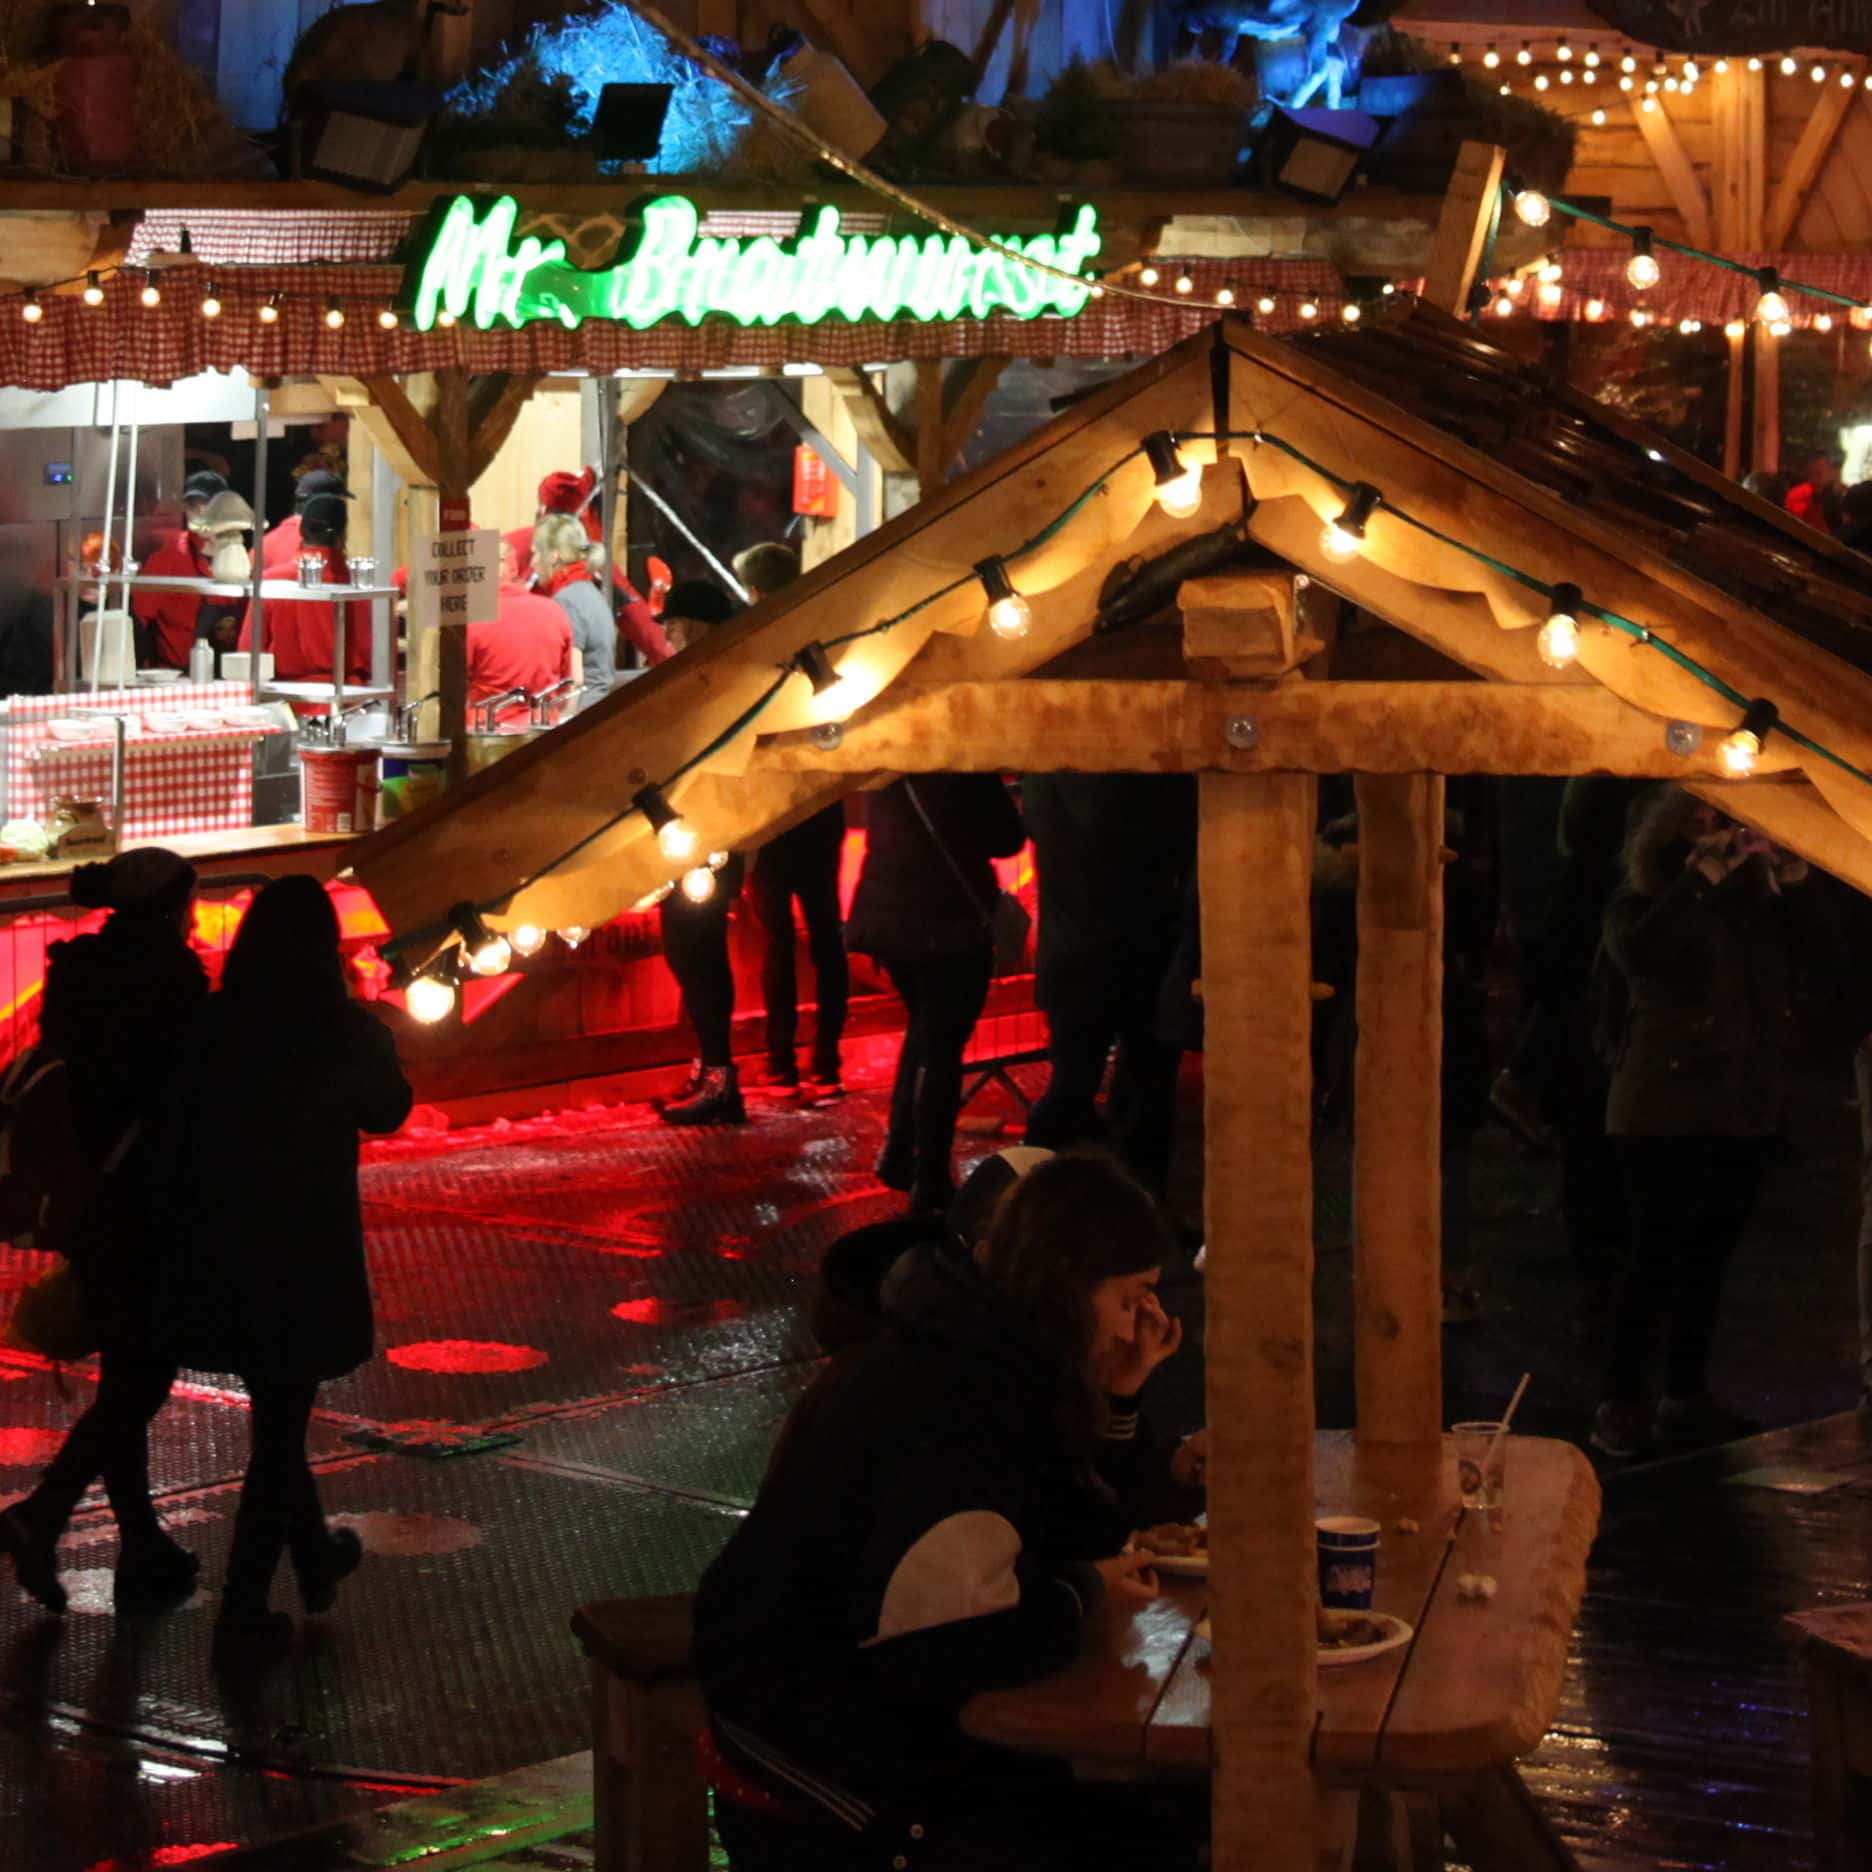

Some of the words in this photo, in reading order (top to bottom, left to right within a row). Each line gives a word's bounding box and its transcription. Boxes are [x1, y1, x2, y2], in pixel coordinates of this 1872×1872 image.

[609, 194, 1103, 331] Bratwurst
[431, 539, 475, 558] COLLECT
[451, 566, 487, 584] ORDER
[440, 594, 467, 613] HERE
